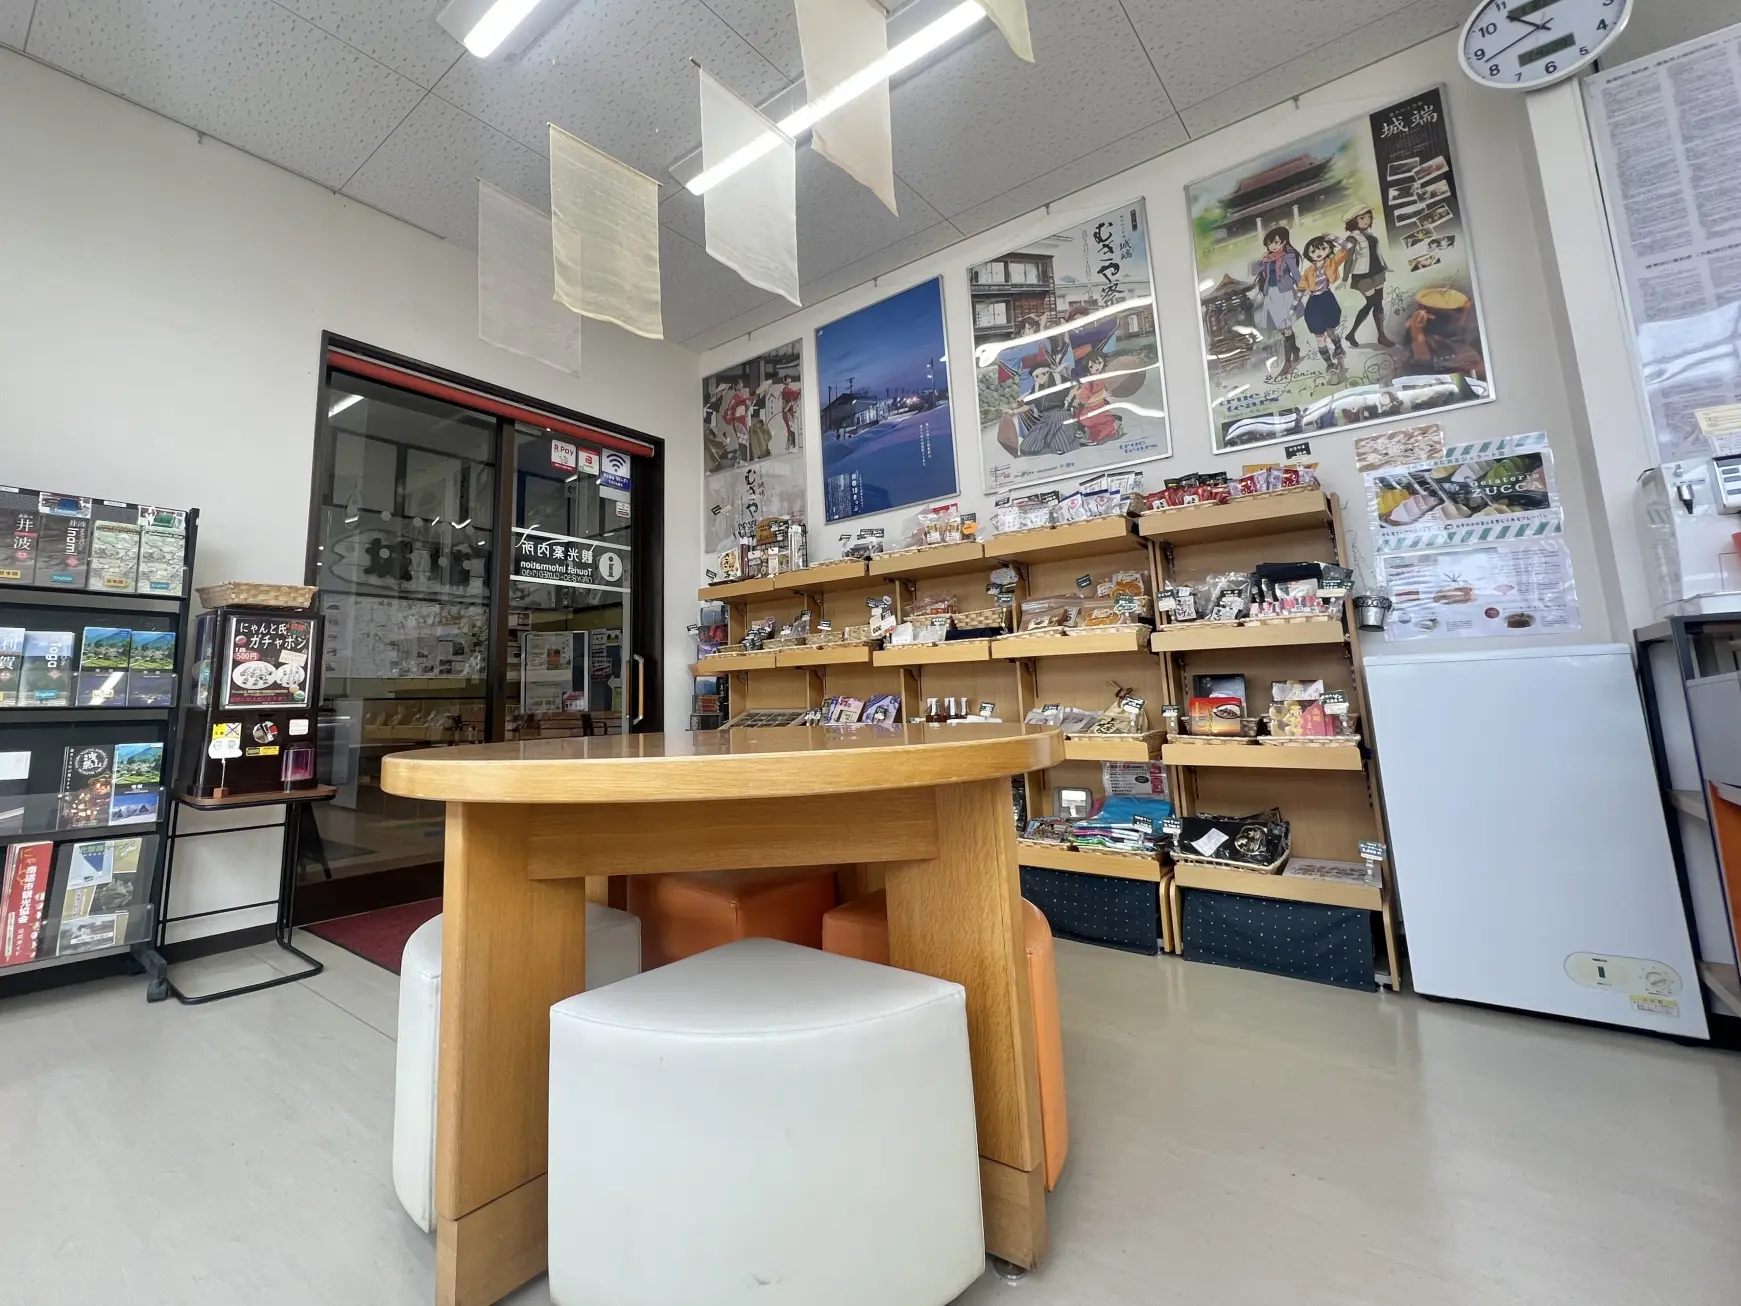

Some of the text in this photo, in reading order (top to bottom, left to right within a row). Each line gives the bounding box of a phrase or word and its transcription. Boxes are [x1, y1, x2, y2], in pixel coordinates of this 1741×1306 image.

[1478, 23, 1498, 38] 10
[1596, 19, 1608, 31] 4
[1474, 48, 1486, 60] 9
[1579, 46, 1589, 56] 5
[1488, 64, 1500, 77] 8
[1545, 61, 1557, 74] 6
[1515, 72, 1523, 82] 7
[1381, 105, 1438, 138] 城端
[603, 472, 629, 484] Free Wi-Fi
[1470, 472, 1541, 487] Gelateria
[1471, 480, 1545, 498] ZUCCA
[14, 518, 34, 550] 井波
[65, 527, 80, 556] Inami
[240, 622, 287, 635] にゃんと氏
[249, 635, 307, 649] ガチャポン
[236, 652, 257, 661] 500円
